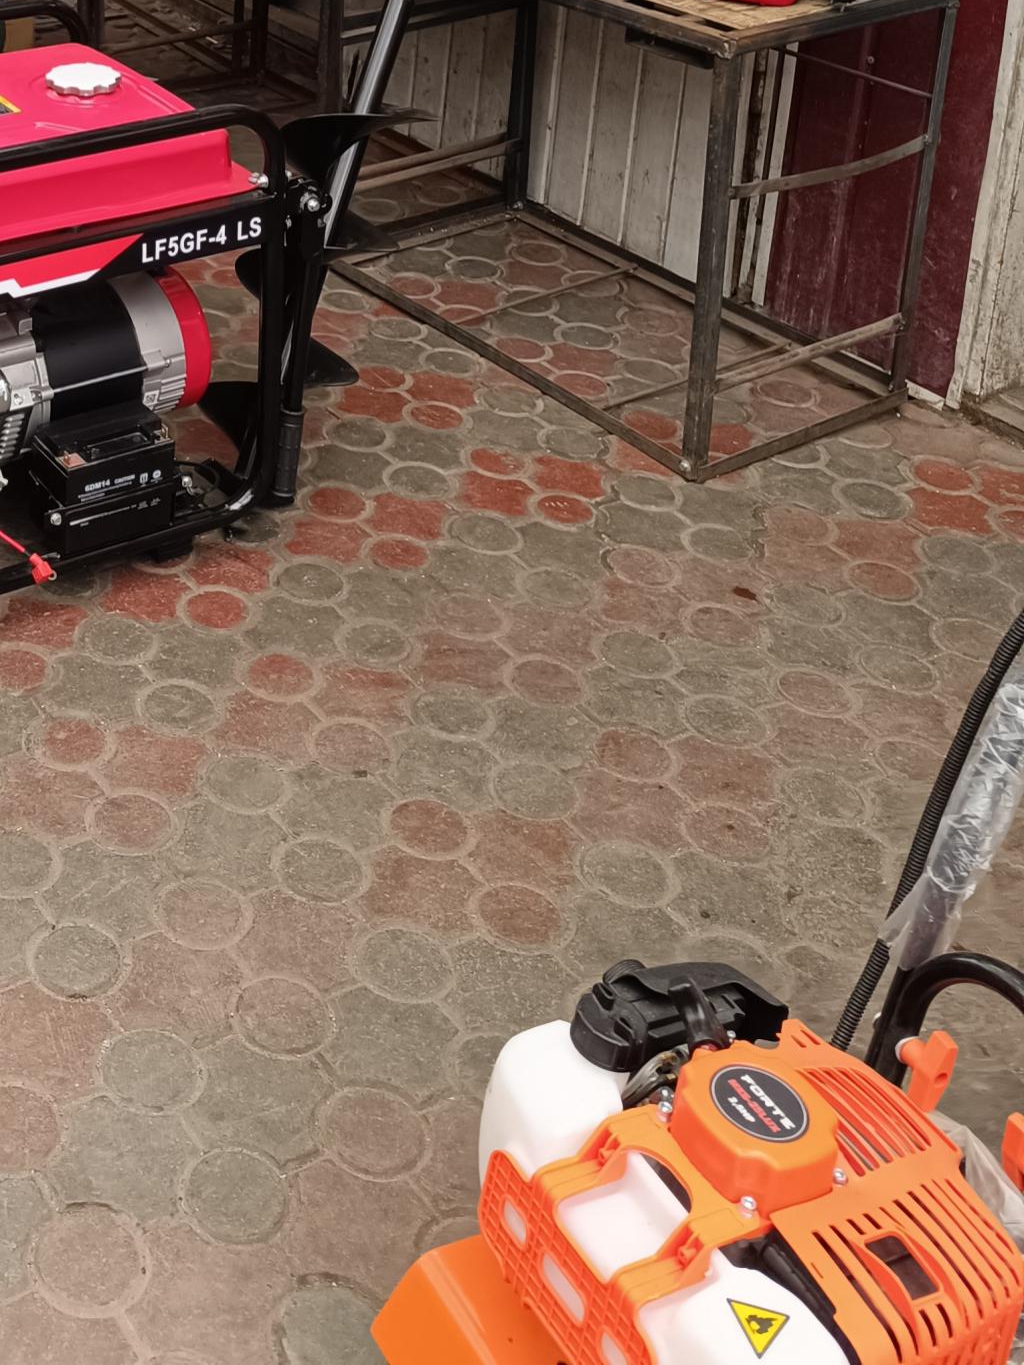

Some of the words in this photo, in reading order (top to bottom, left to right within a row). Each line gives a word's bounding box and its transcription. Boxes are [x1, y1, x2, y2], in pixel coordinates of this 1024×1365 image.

[141, 224, 226, 263] LF5GF-4
[235, 216, 262, 242] LS
[740, 1074, 796, 1130] FORTE
